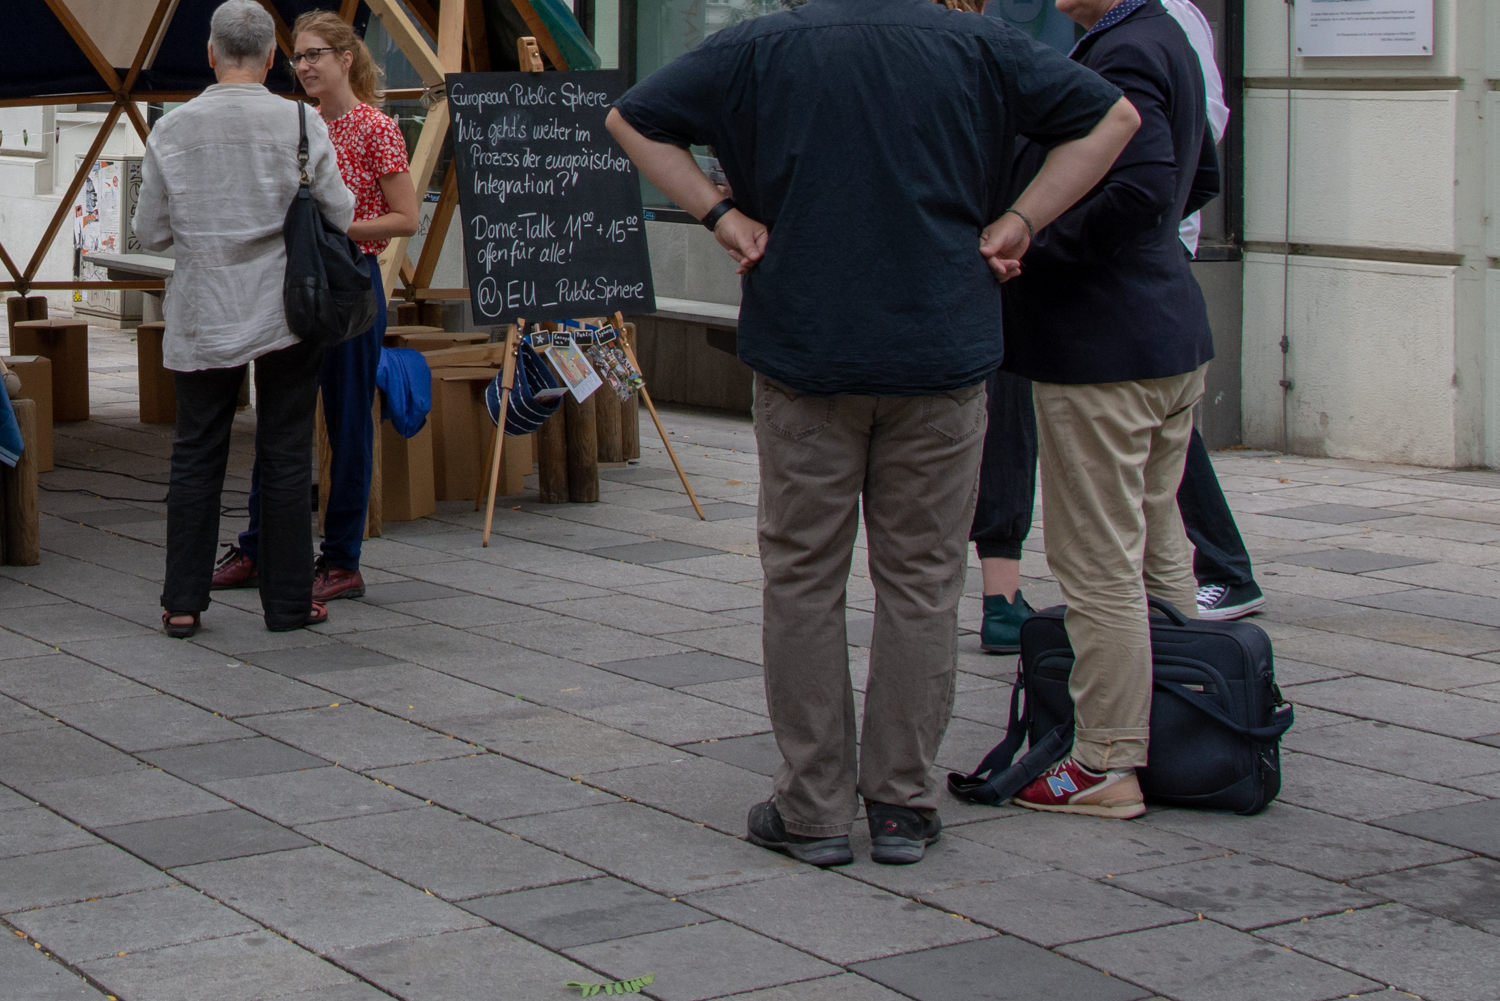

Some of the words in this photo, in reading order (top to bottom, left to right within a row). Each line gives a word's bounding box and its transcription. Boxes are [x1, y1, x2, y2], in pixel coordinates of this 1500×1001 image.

[451, 83, 509, 113] European
[510, 83, 556, 106] Public
[561, 82, 611, 113] Sphere
[533, 118, 572, 142] weiter
[575, 123, 591, 142] im
[470, 144, 520, 168] Prozess
[522, 147, 541, 168] der
[545, 148, 631, 176] europäischen
[510, 241, 536, 267] für
[539, 242, 574, 264] alle!
